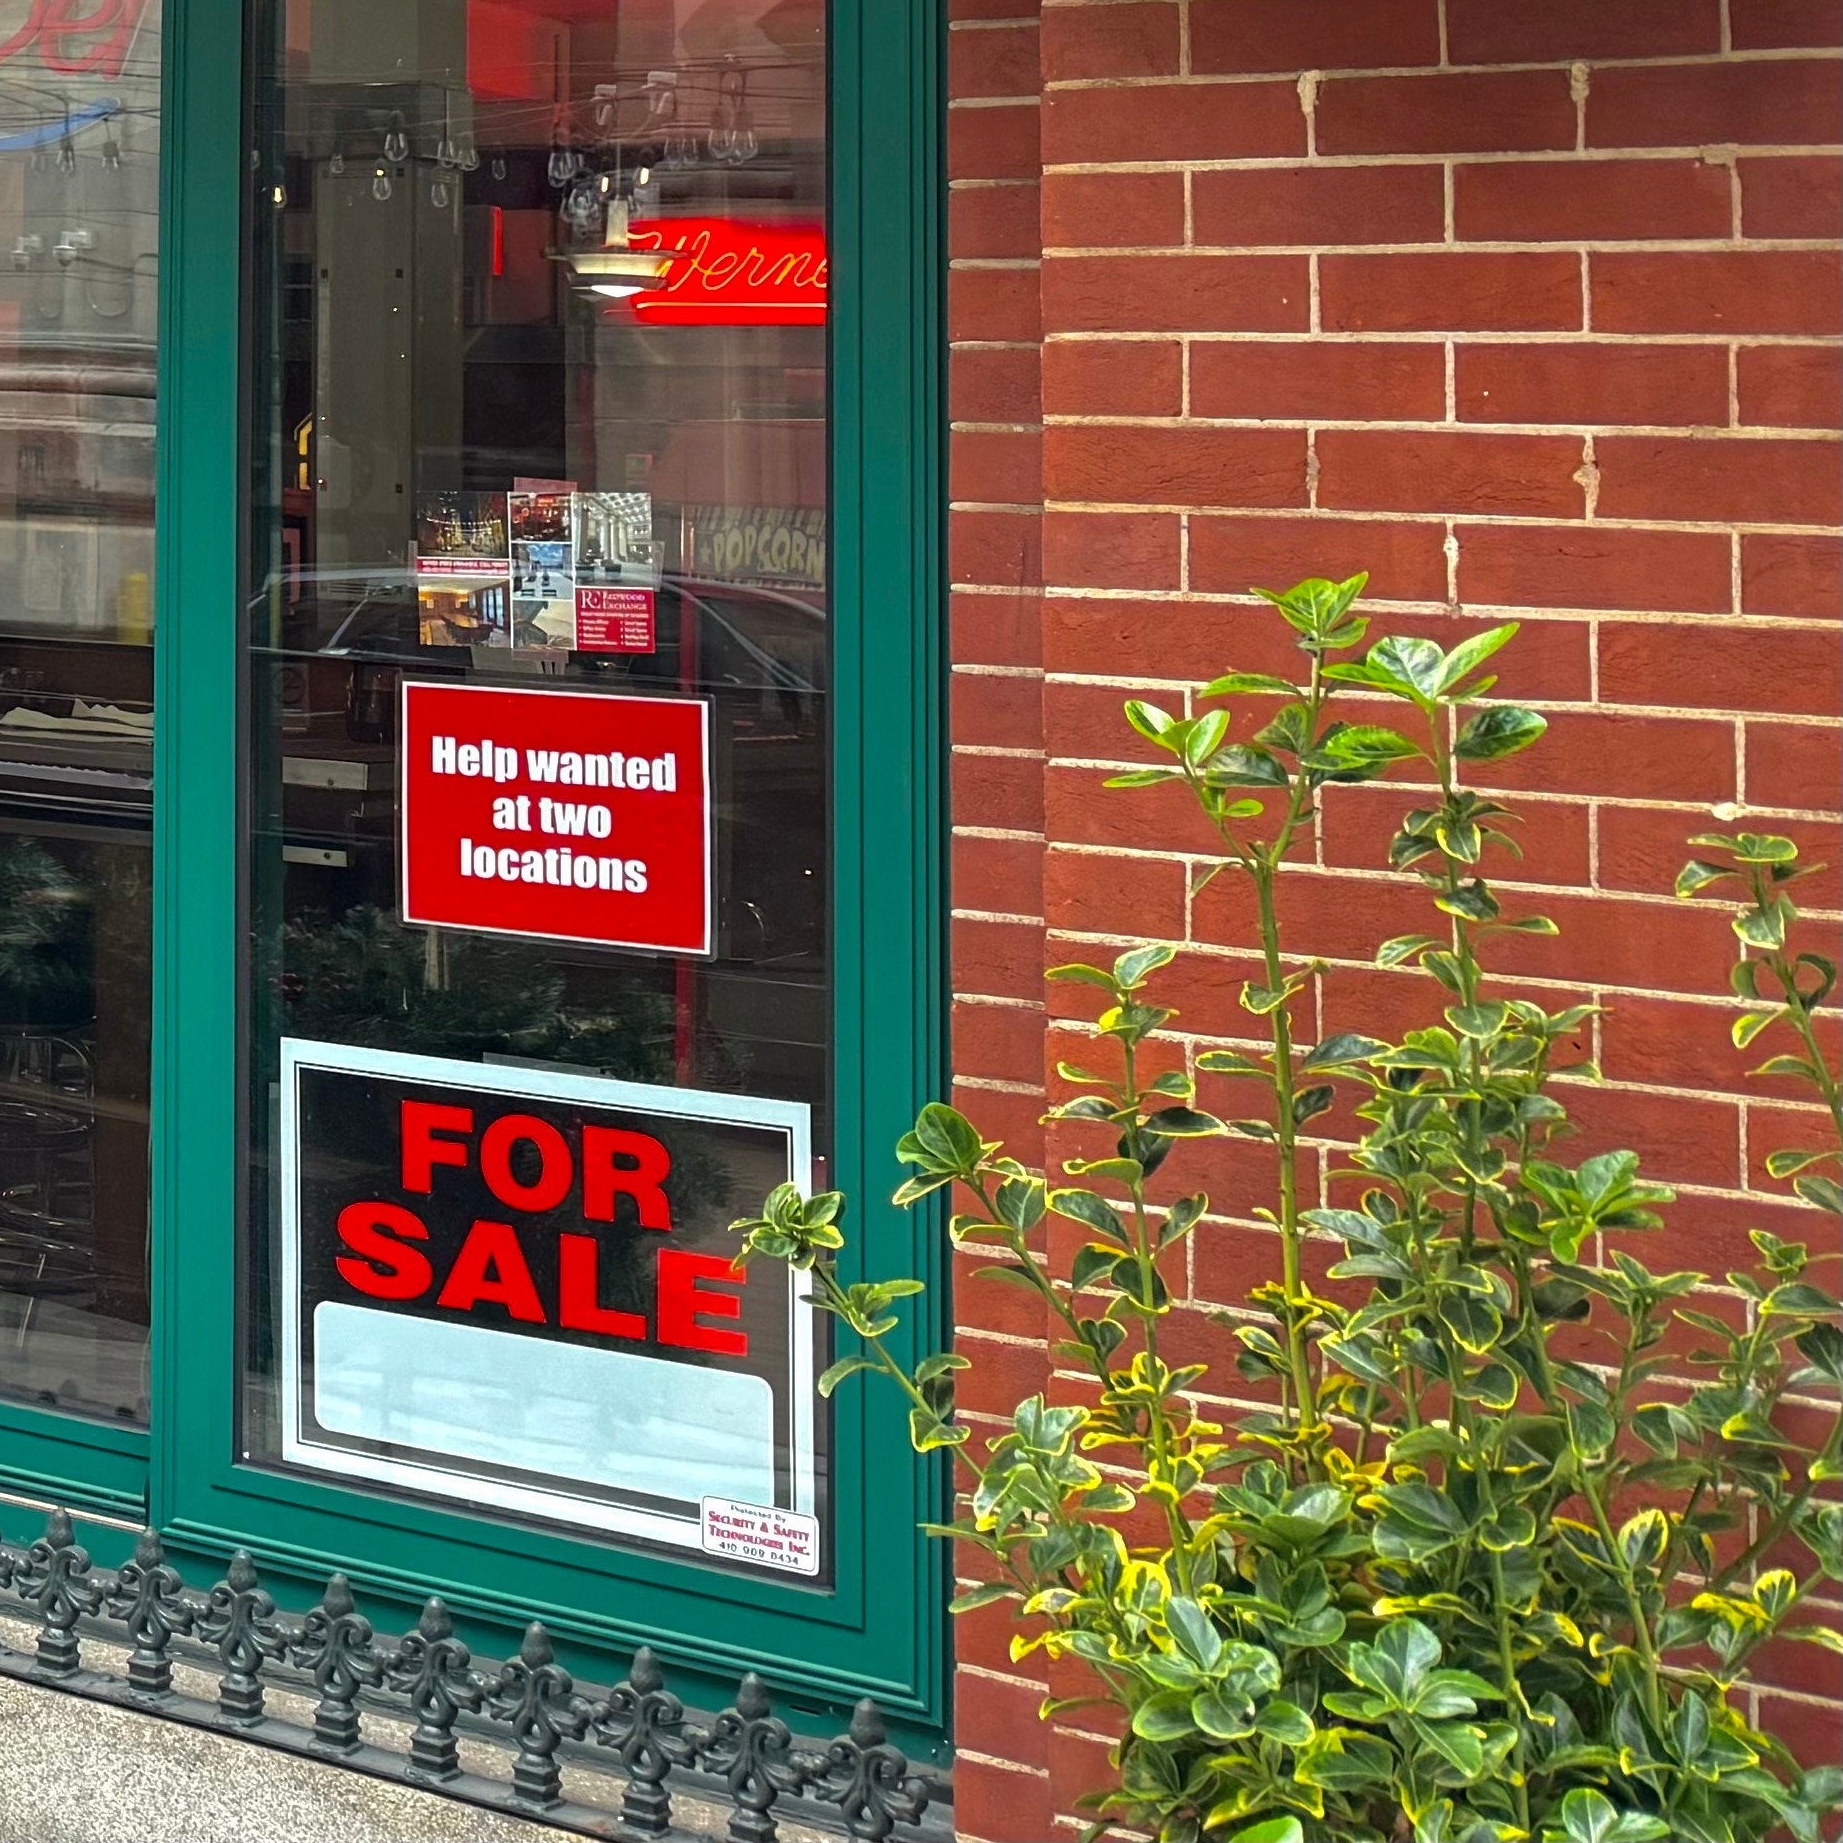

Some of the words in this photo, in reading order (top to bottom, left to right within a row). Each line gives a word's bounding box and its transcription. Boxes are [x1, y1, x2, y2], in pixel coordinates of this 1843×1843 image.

[432, 735, 518, 783] Help
[526, 749, 677, 792] wanted
[492, 795, 532, 832] at
[539, 797, 612, 839] two
[460, 837, 648, 894] locations
[401, 1099, 672, 1232] FOR
[335, 1201, 748, 1357] SALE
